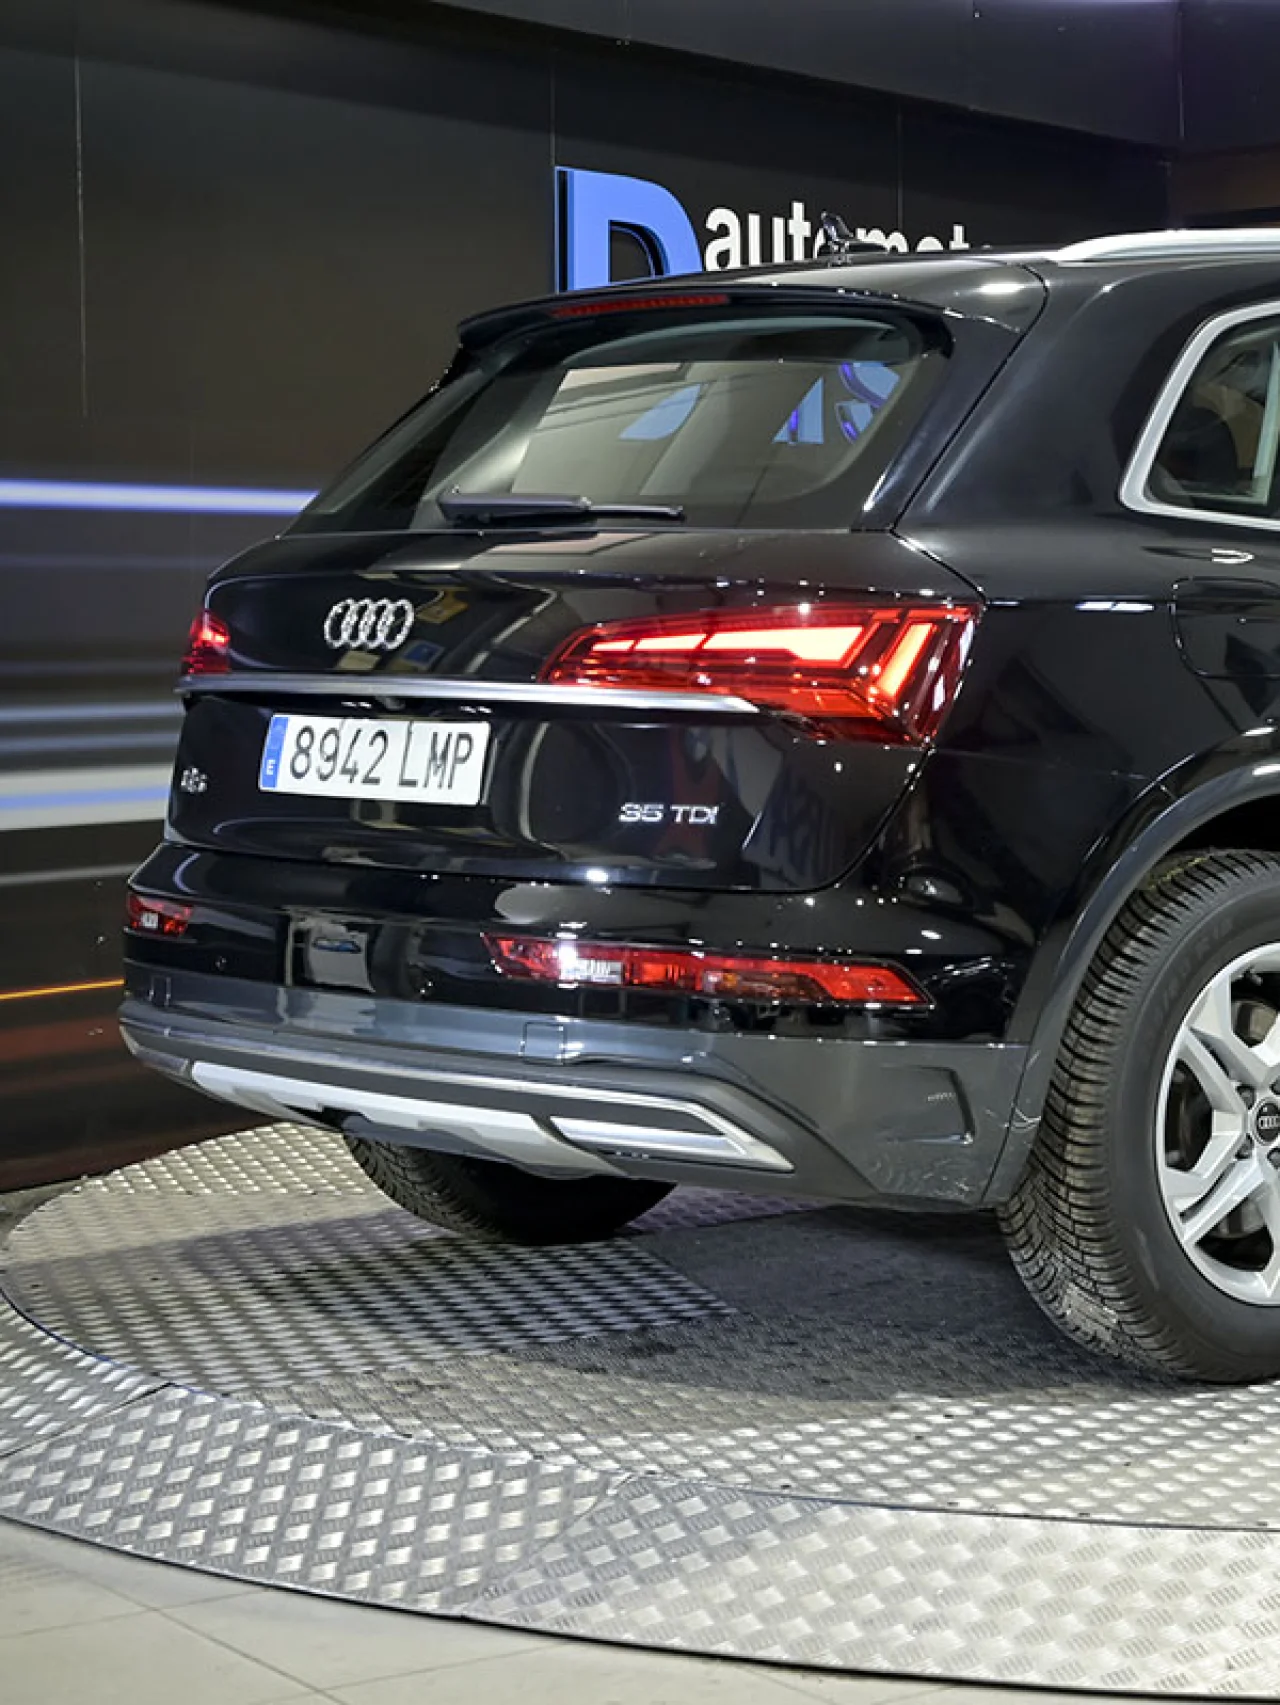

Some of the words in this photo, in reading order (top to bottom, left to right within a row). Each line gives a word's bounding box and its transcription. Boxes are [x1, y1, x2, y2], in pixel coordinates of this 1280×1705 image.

[290, 725, 389, 785] 8942
[398, 730, 474, 789] LMP
[670, 804, 719, 824] TDI
